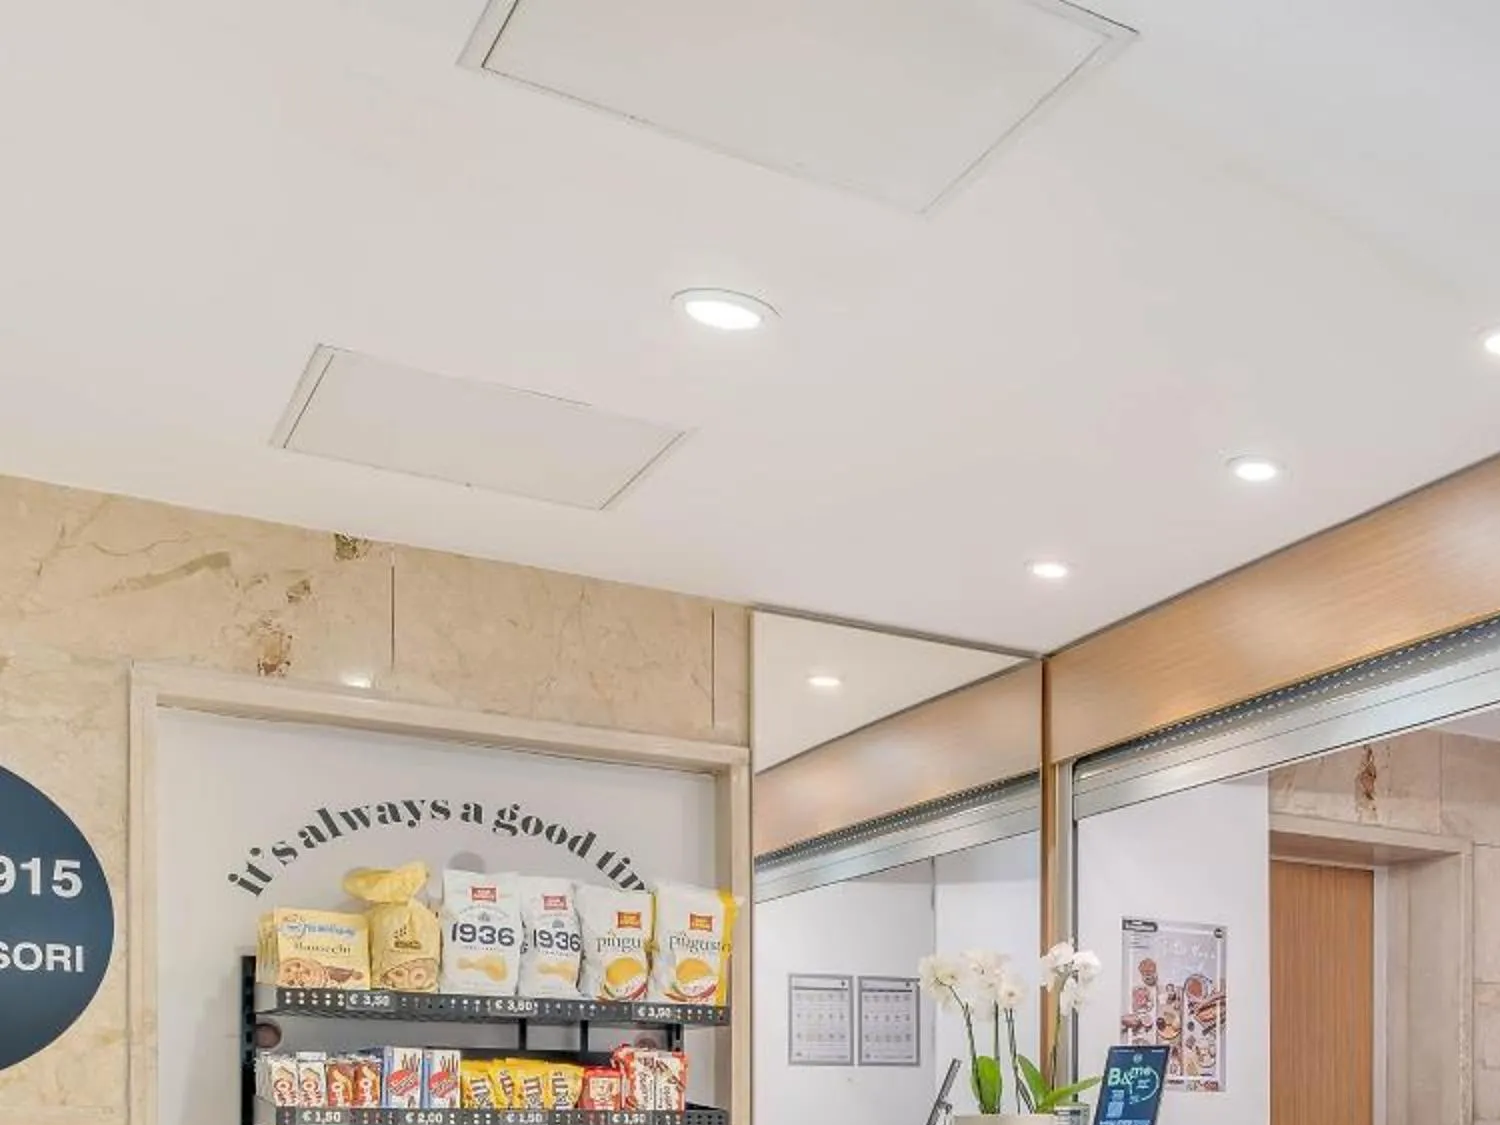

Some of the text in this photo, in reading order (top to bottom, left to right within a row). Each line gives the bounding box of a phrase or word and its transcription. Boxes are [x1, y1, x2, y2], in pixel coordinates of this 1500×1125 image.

[227, 840, 298, 896] it's
[298, 797, 451, 849] always
[460, 802, 483, 825] a
[492, 803, 597, 859] good
[451, 921, 515, 947] 1936
[533, 929, 581, 952] 1936
